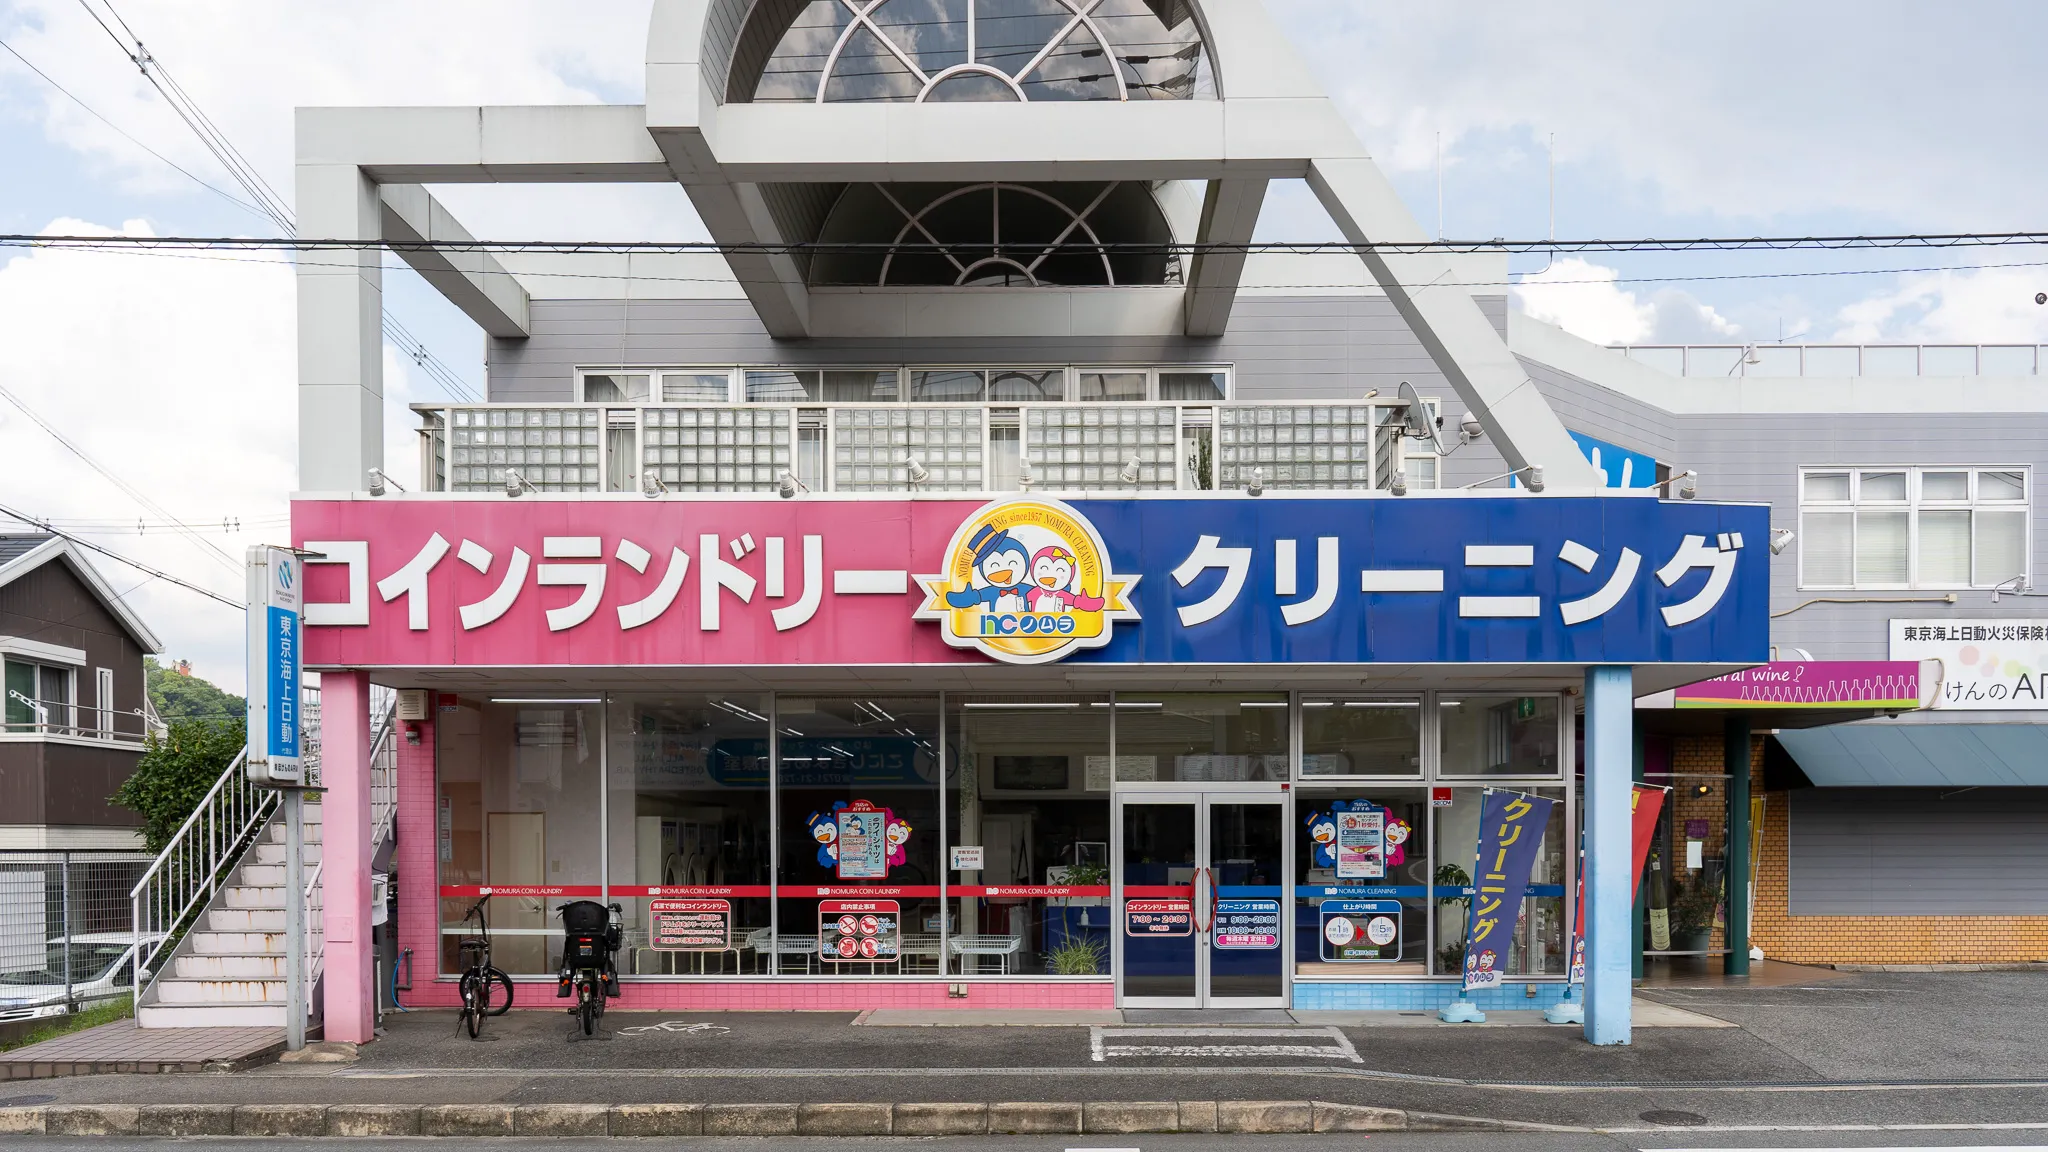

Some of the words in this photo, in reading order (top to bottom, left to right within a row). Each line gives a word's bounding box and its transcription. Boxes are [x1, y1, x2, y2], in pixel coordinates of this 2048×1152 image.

[304, 531, 908, 631] コインランドリー
[958, 549, 973, 578] NOMUR
[1045, 514, 1075, 539] NOMURA
[1072, 536, 1094, 577] CLEANING
[1171, 531, 1744, 627] クリーニング
[279, 615, 293, 744] 東京海上日動
[1752, 667, 1790, 682] wine
[1132, 915, 1152, 923] 7:00
[1162, 915, 1187, 923] 24:00
[1472, 798, 1533, 944] クリーニング
